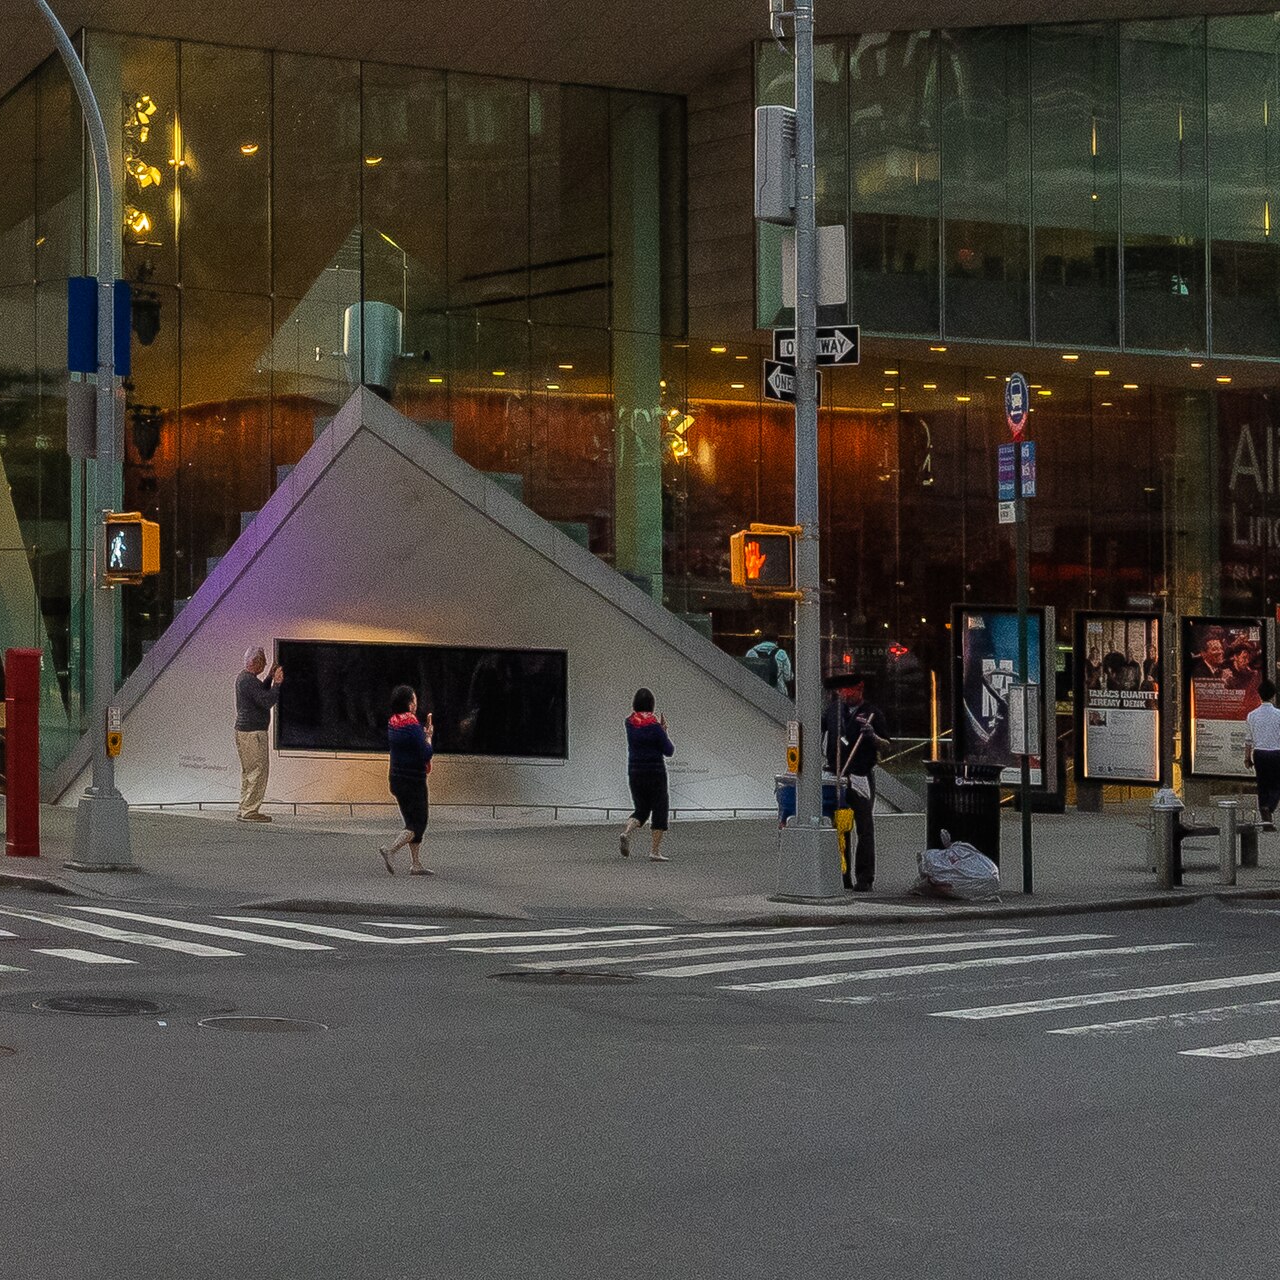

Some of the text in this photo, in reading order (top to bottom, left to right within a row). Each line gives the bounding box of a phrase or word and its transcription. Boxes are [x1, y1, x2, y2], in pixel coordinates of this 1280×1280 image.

[820, 339, 846, 353] WAY
[774, 374, 793, 390] ONE
[1088, 698, 1121, 707] JEREMY
